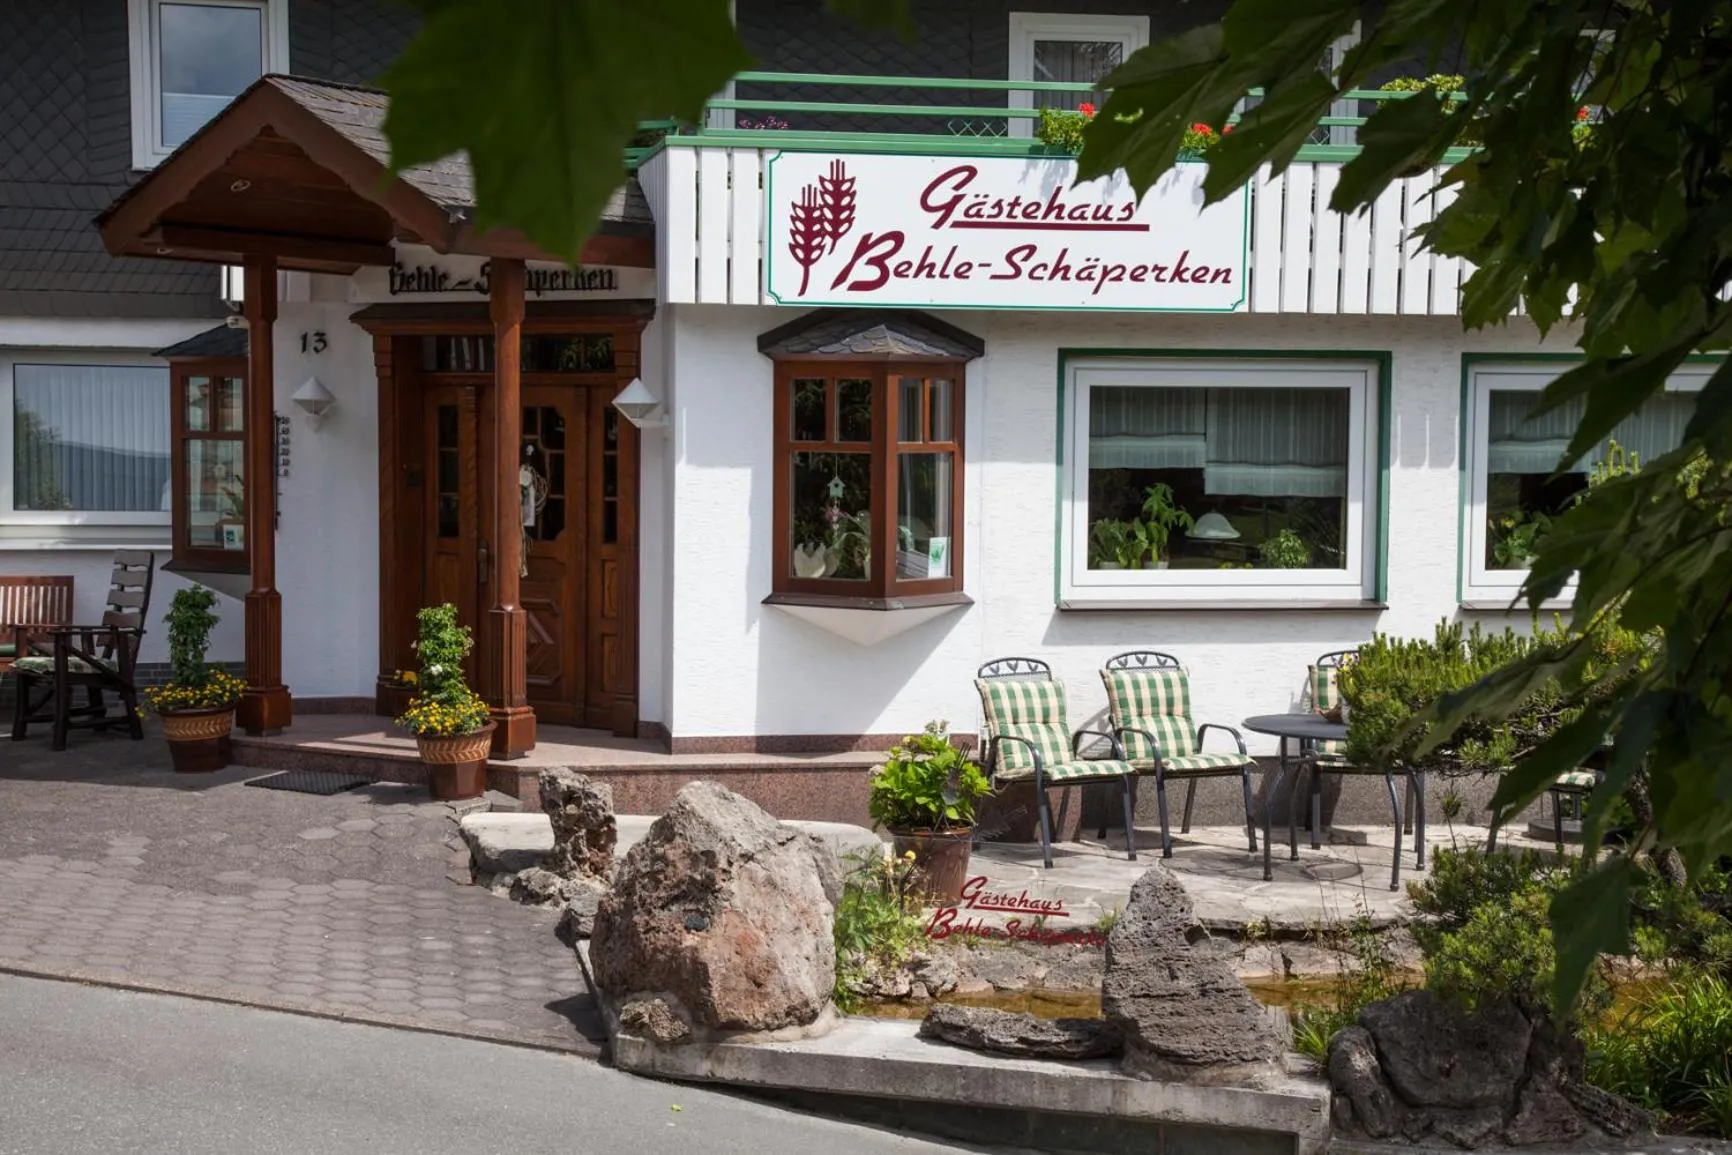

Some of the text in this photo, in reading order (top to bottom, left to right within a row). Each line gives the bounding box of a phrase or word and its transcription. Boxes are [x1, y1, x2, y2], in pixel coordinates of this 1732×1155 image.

[920, 165, 1135, 229] Gästehaus
[830, 231, 1232, 295] Behle-Schäperken
[301, 331, 328, 354] 13
[960, 876, 1064, 910] Gästehaus
